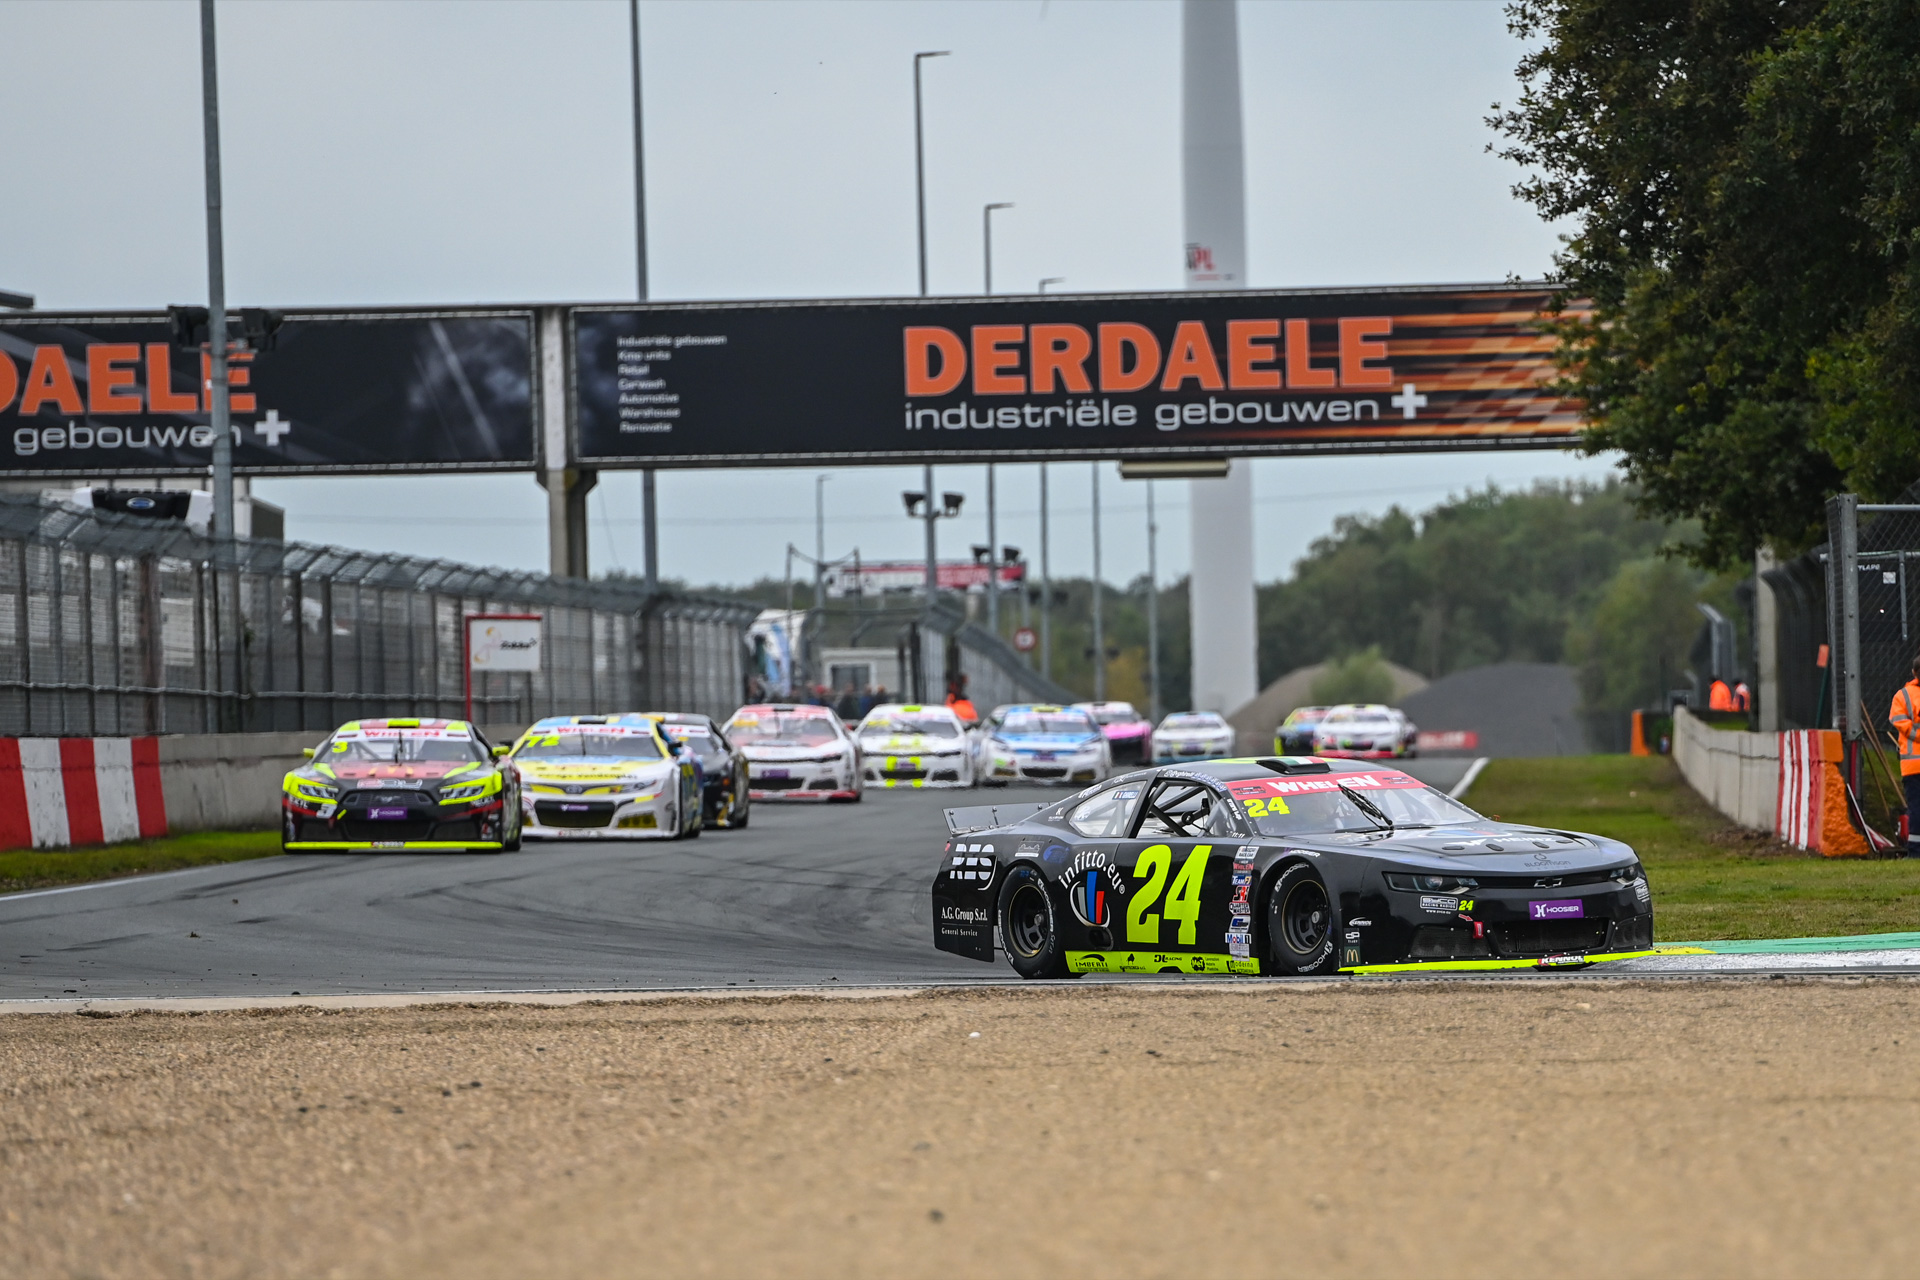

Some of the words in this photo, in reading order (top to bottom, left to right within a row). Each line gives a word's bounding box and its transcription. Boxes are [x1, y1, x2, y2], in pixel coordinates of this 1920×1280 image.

[904, 316, 1394, 396] DERDAELE
[905, 399, 1137, 431] industriële
[1155, 397, 1380, 431] gebouwen
[332, 741, 348, 754] 3
[1266, 775, 1381, 793] WHELEN
[1243, 796, 1290, 818] 24
[1126, 844, 1213, 945] 24
[1458, 899, 1475, 911] 24
[1546, 905, 1579, 913] HOOSIER
[941, 906, 954, 920] A.G.
[955, 907, 974, 924] Group
[941, 927, 959, 936] General
[960, 928, 978, 937] Service
[1227, 934, 1244, 944] Mobil
[1541, 955, 1584, 964] KENNOL
